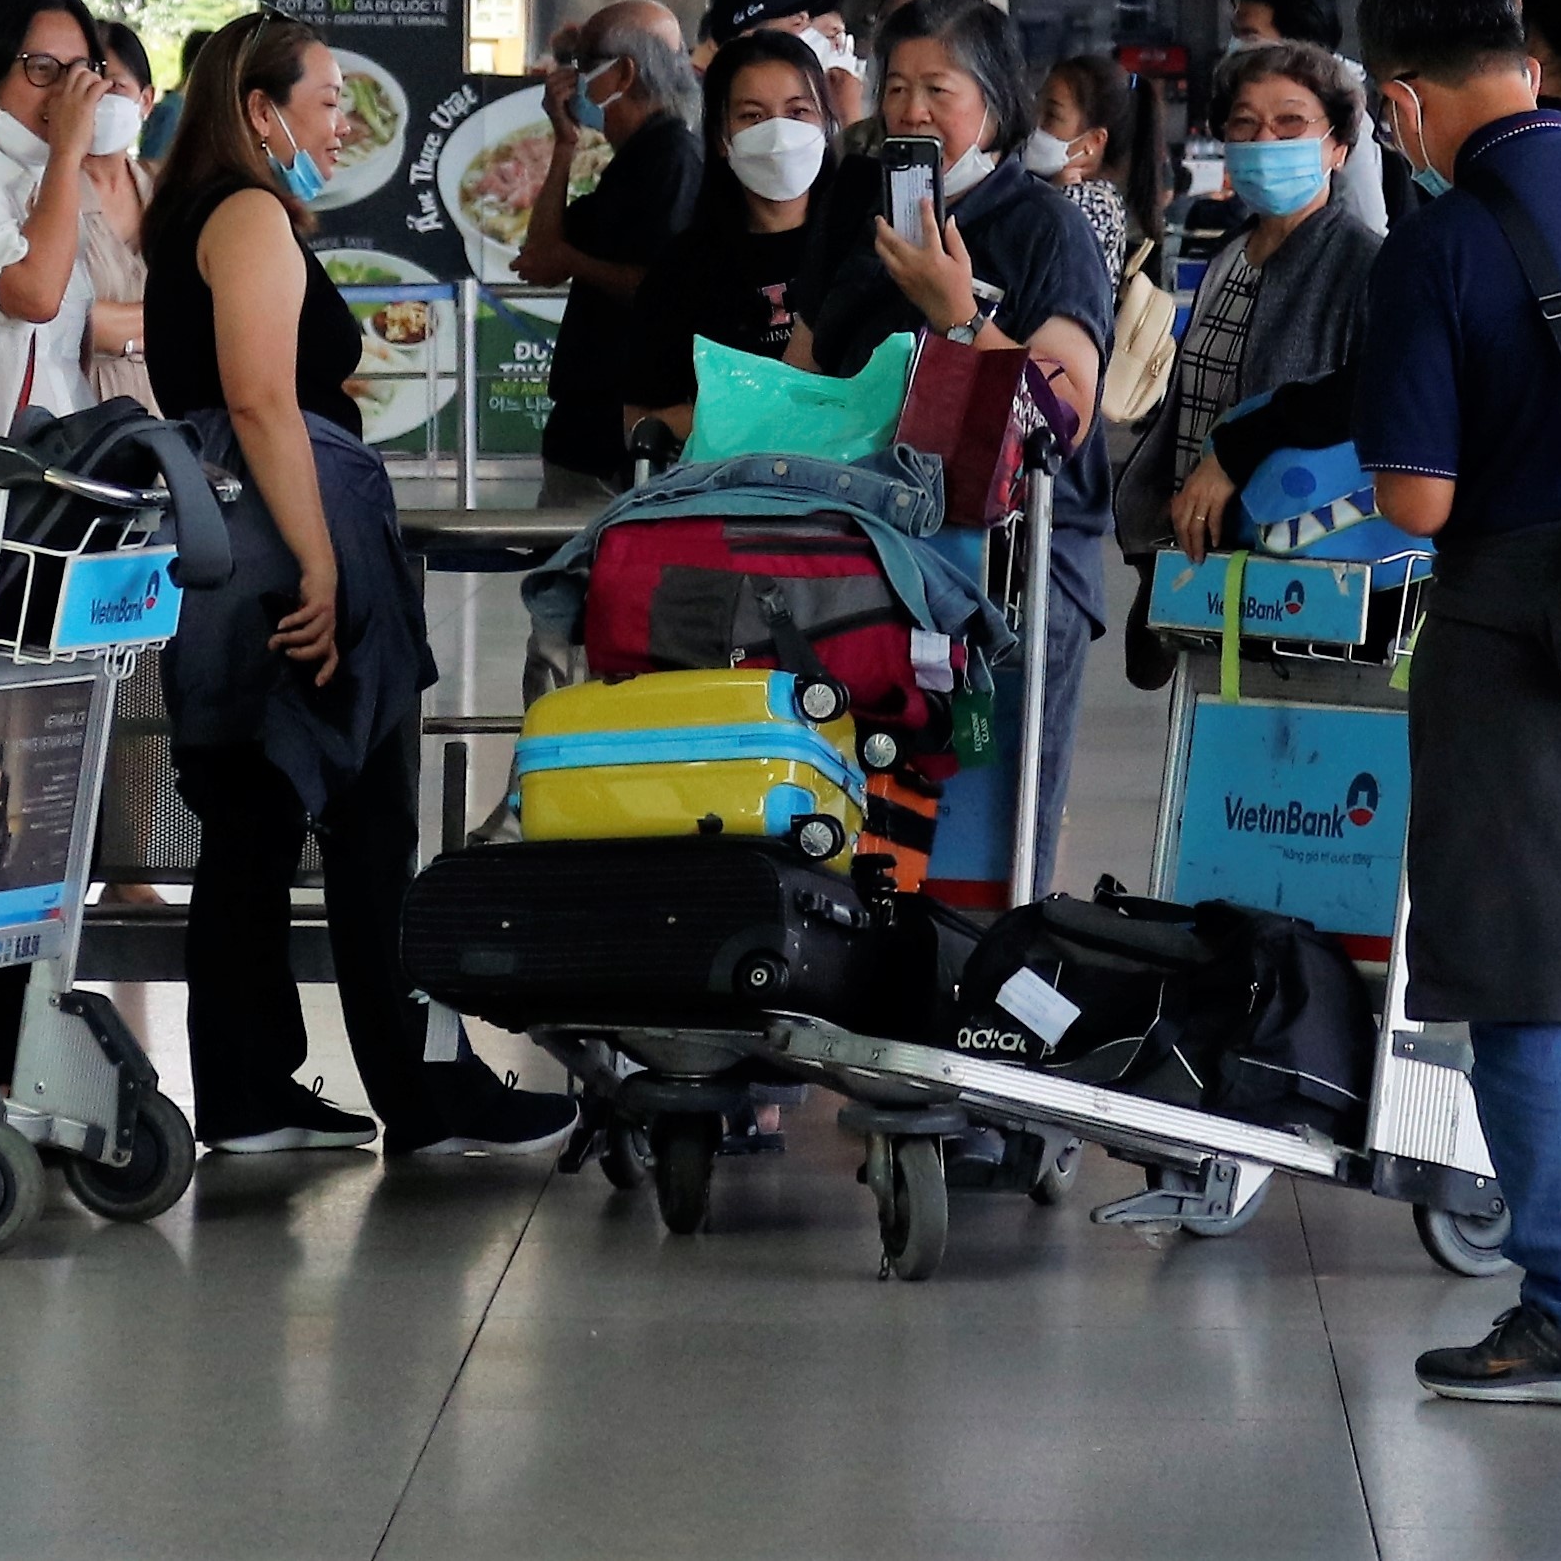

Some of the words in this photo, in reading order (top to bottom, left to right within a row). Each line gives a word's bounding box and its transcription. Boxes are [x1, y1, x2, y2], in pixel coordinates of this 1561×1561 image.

[354, 0, 374, 12] GA
[334, 14, 394, 26] DEPARTURE
[397, 14, 447, 27] TERMINAL
[91, 596, 144, 625] VietinBank
[1224, 791, 1345, 839] VietinBank
